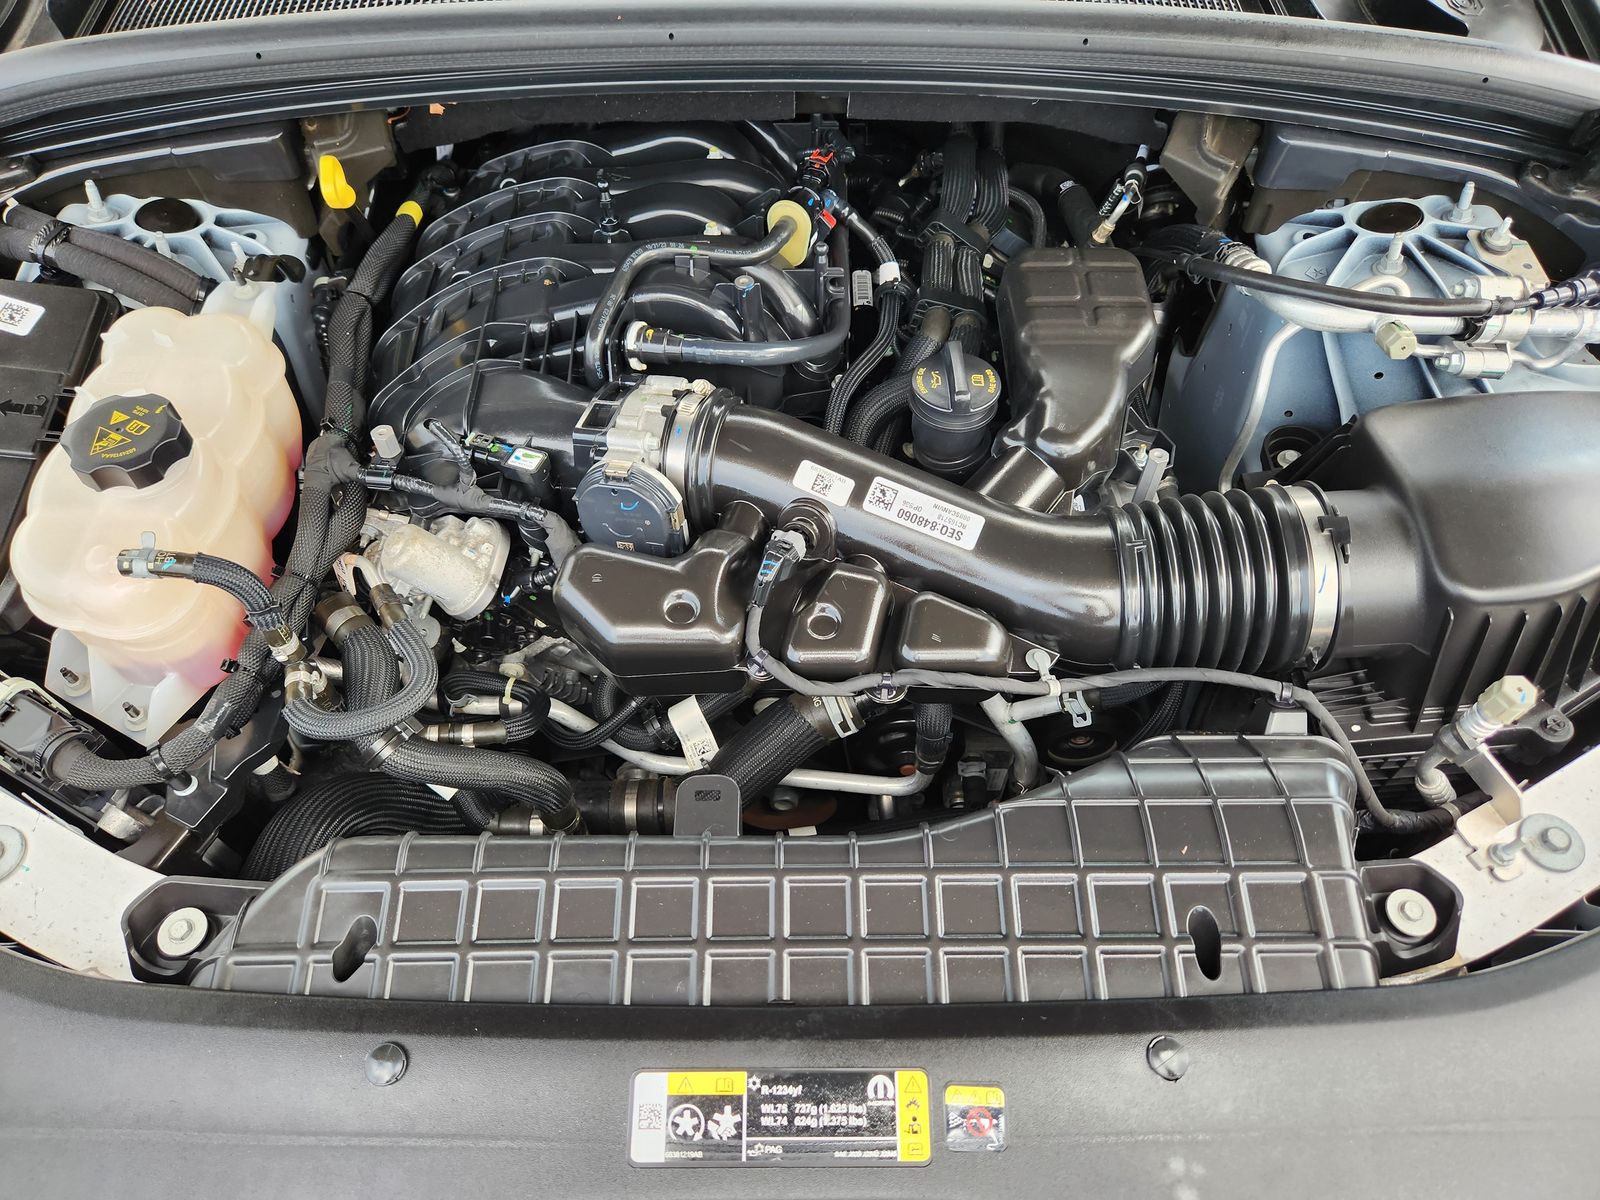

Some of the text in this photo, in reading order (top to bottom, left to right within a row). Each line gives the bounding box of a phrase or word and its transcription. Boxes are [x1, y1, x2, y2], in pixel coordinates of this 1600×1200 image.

[896, 508, 964, 542] SEQ:848060
[760, 1084, 803, 1098] R-1234yf
[760, 1103, 788, 1114] WL75
[760, 1116, 788, 1126] WL74
[764, 1145, 783, 1154] PAG
